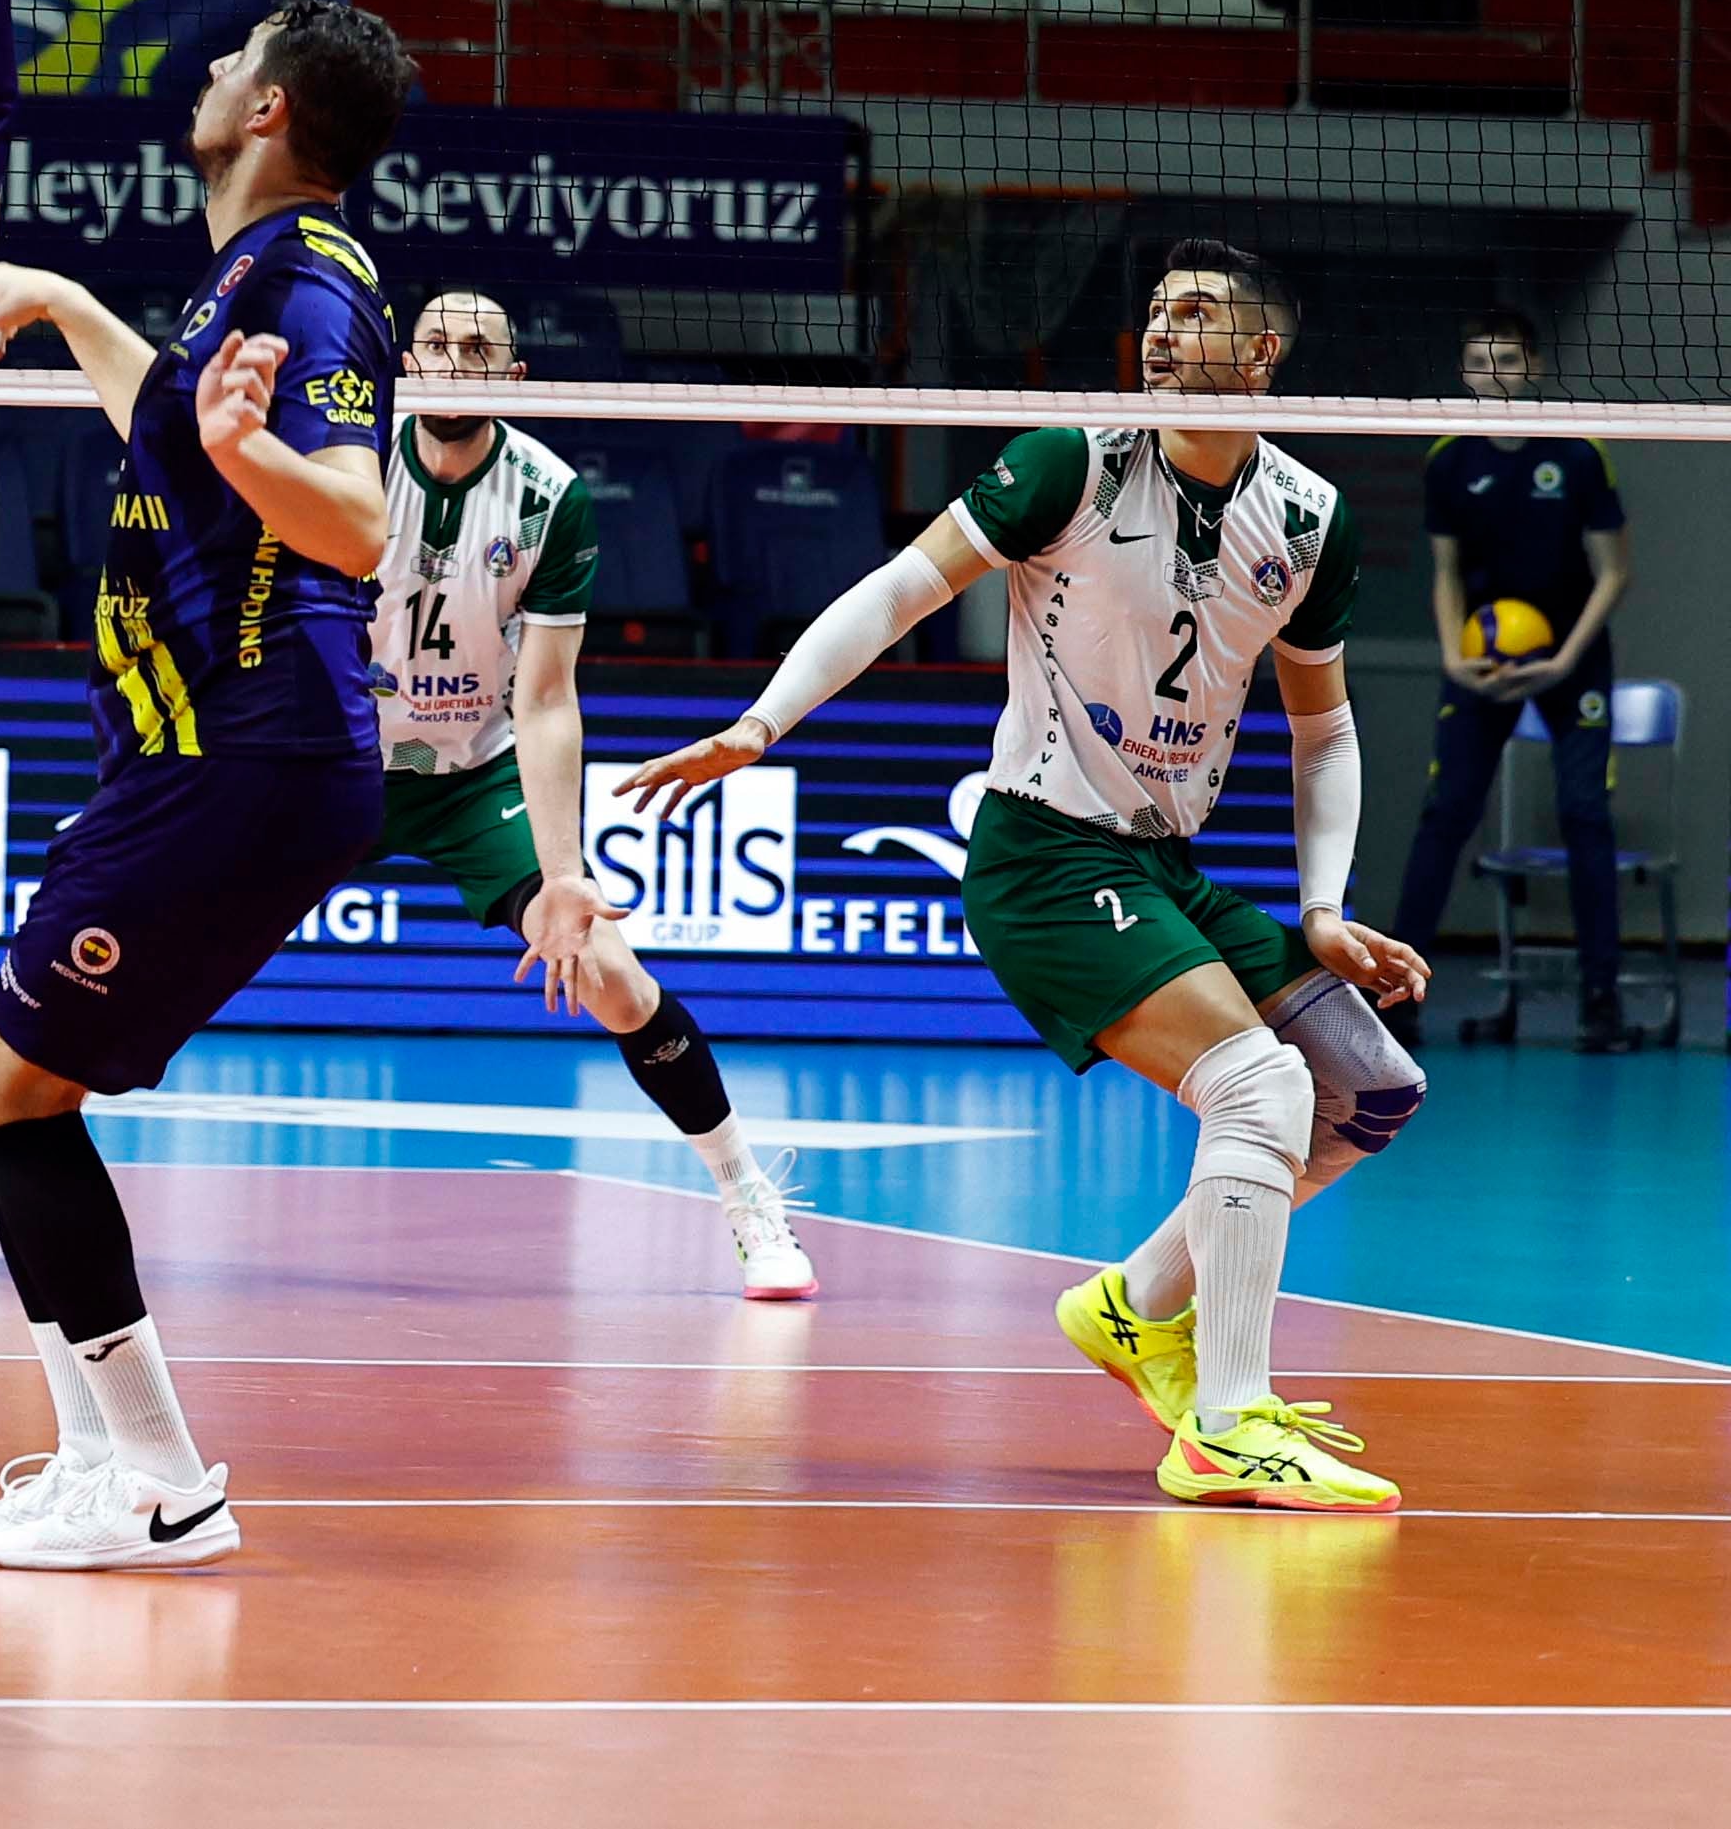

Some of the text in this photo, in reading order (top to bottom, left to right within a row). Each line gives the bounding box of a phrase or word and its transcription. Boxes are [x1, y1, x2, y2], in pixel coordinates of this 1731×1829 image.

[370, 152, 820, 255] Seviyoruz
[325, 407, 378, 429] GROUP
[405, 588, 457, 661] 14
[1154, 609, 1200, 704] 2
[412, 673, 480, 698] HNS
[454, 710, 481, 724] RES
[1148, 714, 1207, 746] HNS
[595, 786, 789, 917] SMS
[653, 921, 722, 943] GRUP
[801, 898, 978, 956] EFEL
[1094, 887, 1139, 934] 2
